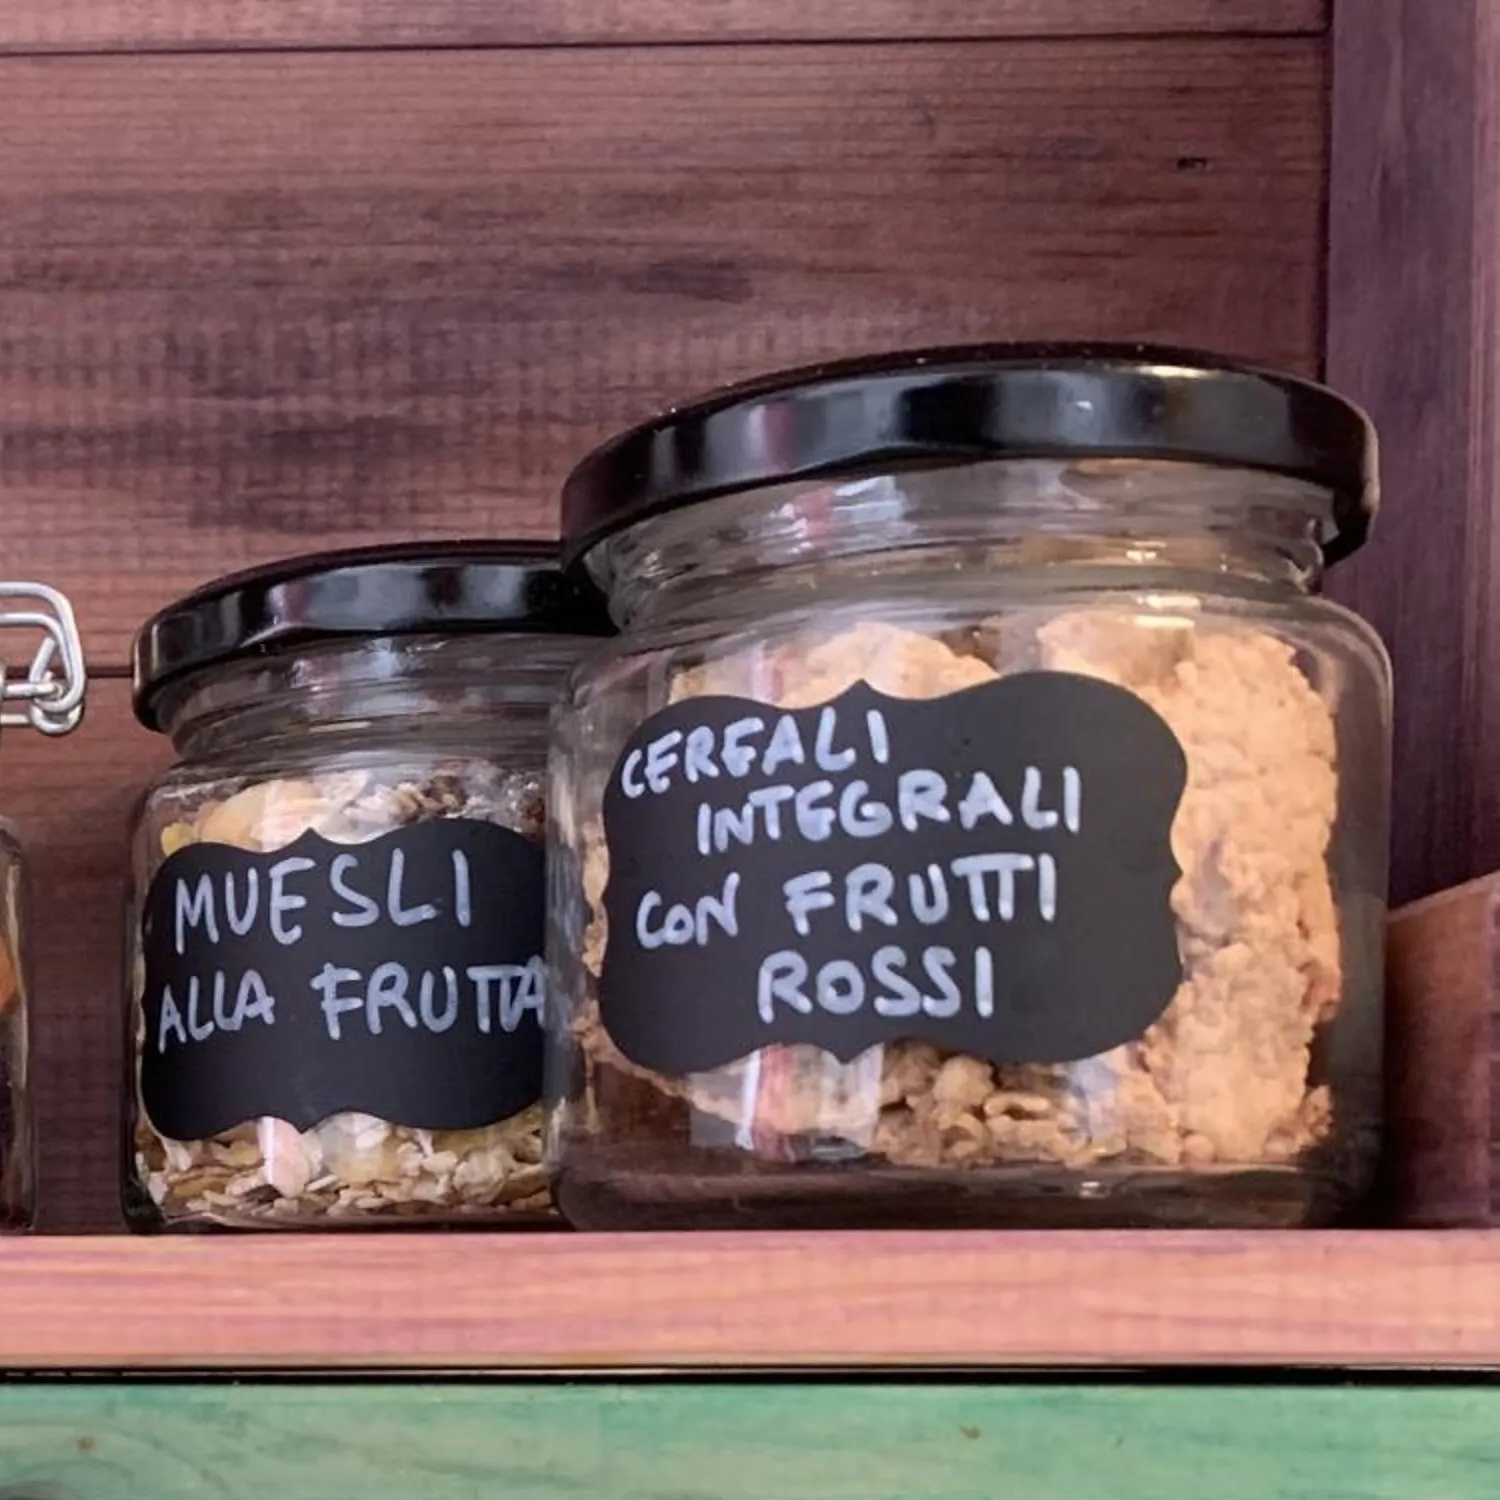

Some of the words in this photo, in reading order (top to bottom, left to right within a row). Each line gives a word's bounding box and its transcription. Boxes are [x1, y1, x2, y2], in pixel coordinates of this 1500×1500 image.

[620, 707, 889, 798] CEREALI
[697, 766, 1082, 854] INTEGRALI
[175, 847, 471, 955] MUESLI
[635, 871, 739, 949] CON
[782, 852, 1056, 934] FRUTTI
[158, 969, 275, 1054] ALLA
[310, 954, 548, 1041] FRUTTA
[757, 945, 994, 1023] ROSSI
